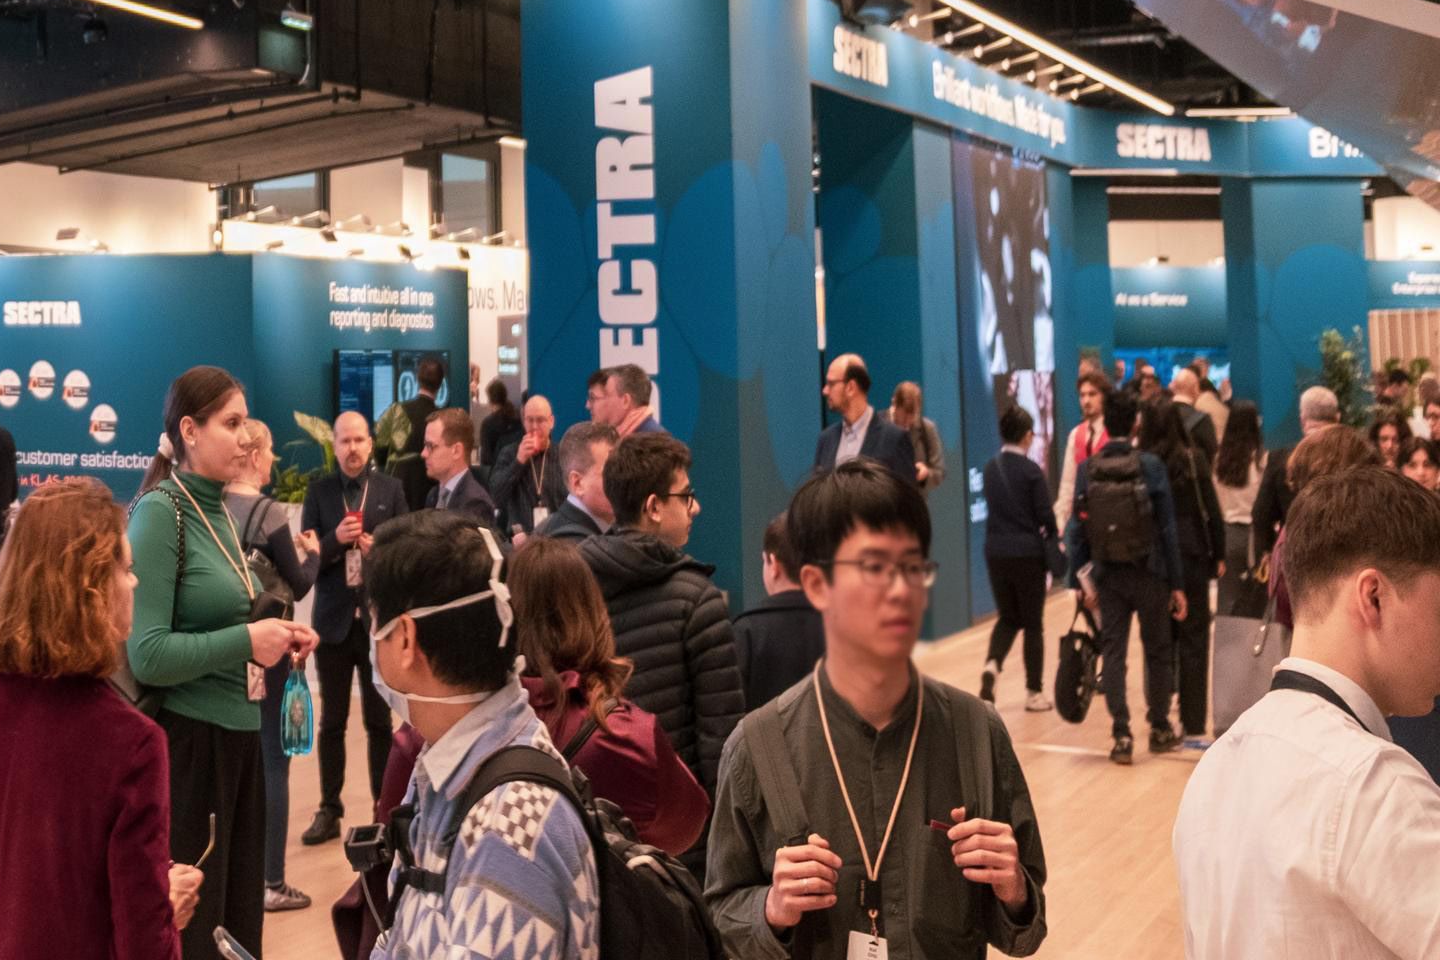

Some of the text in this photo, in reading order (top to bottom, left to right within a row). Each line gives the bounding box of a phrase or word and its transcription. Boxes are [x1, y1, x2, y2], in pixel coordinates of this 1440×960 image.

[1116, 123, 1212, 162] SECTRA
[594, 65, 661, 425] ECTRA
[329, 281, 349, 302] Fast
[350, 284, 366, 303] and
[3, 301, 81, 325] SECTRA
[330, 307, 434, 333] reporting and diagnostics
[16, 450, 78, 467] customer
